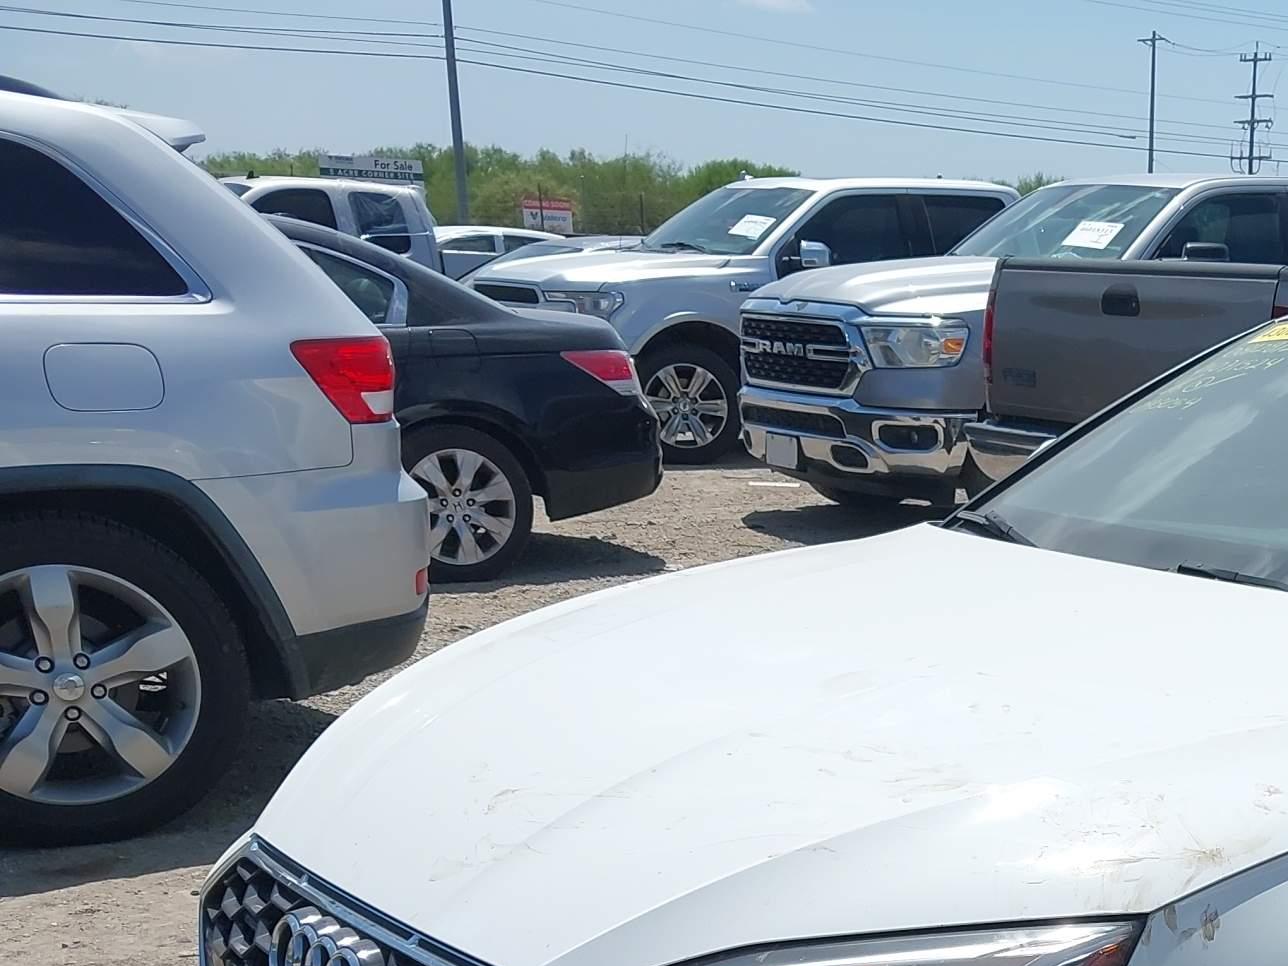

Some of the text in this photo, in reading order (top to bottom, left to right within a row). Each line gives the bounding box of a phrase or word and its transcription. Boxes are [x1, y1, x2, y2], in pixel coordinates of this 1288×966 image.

[374, 159, 413, 171] For Sale
[758, 340, 804, 356] RAM
